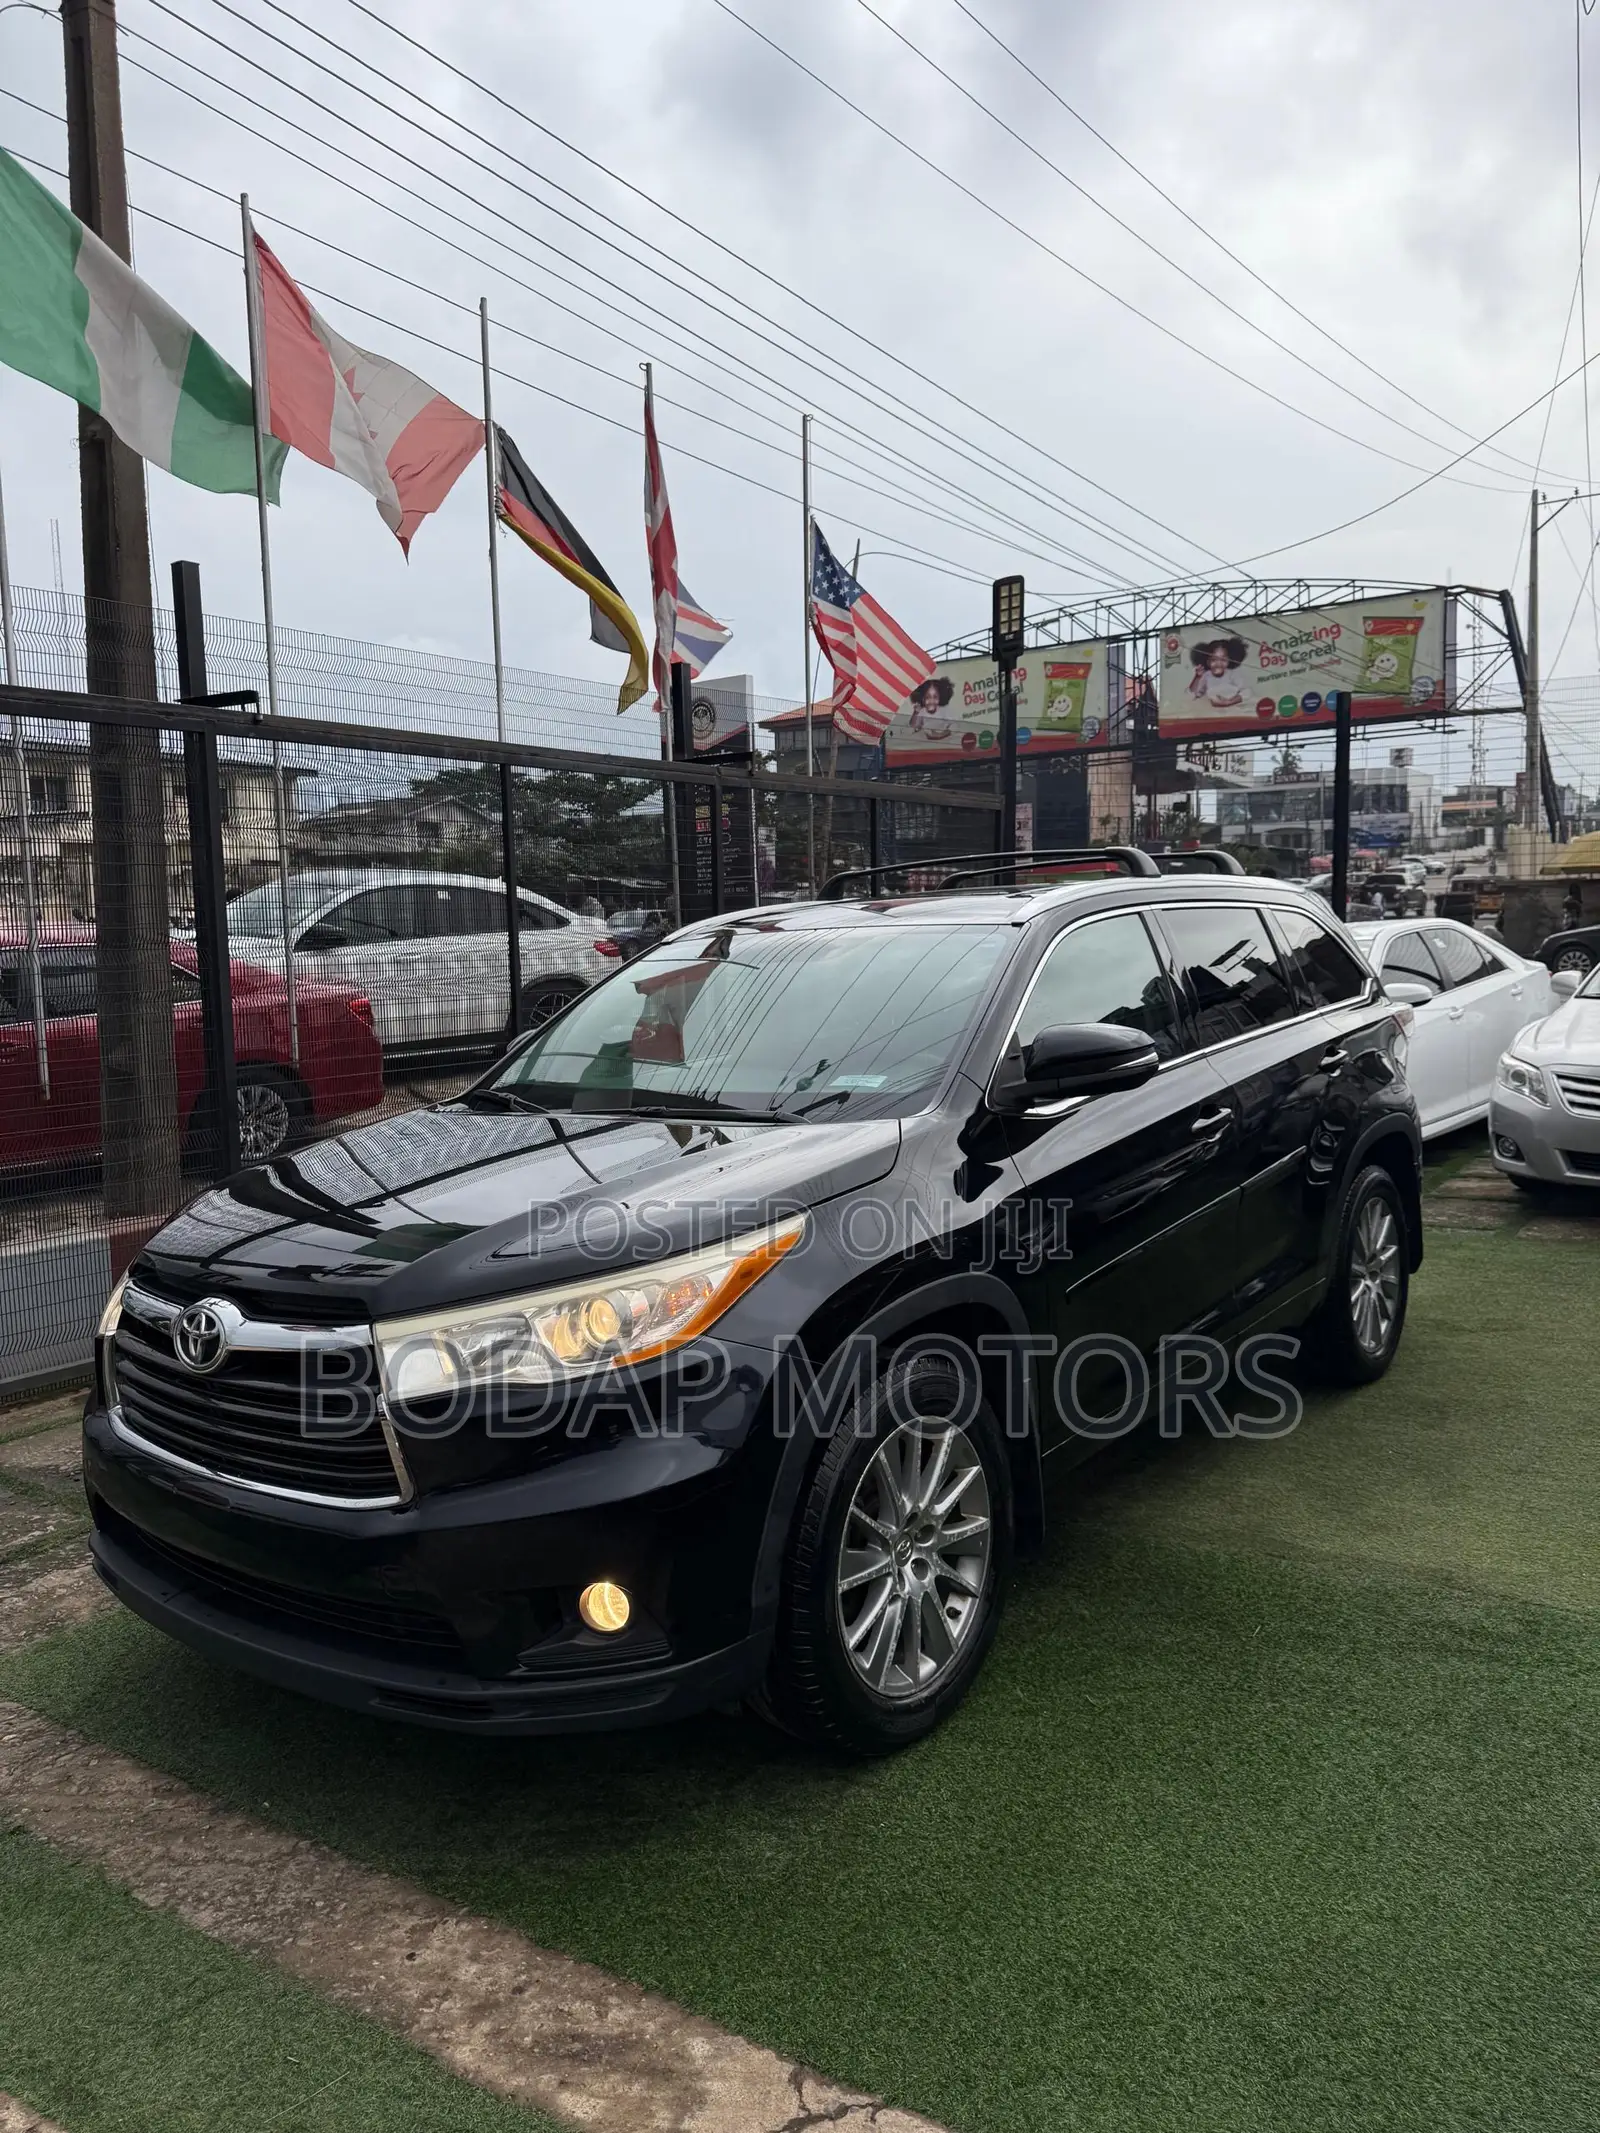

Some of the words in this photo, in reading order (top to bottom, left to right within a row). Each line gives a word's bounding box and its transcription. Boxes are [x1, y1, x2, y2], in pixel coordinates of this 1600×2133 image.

[1259, 623, 1342, 657] Amaizing
[1260, 653, 1288, 668] Day
[1290, 640, 1337, 664] Cereal
[964, 692, 986, 706] Day
